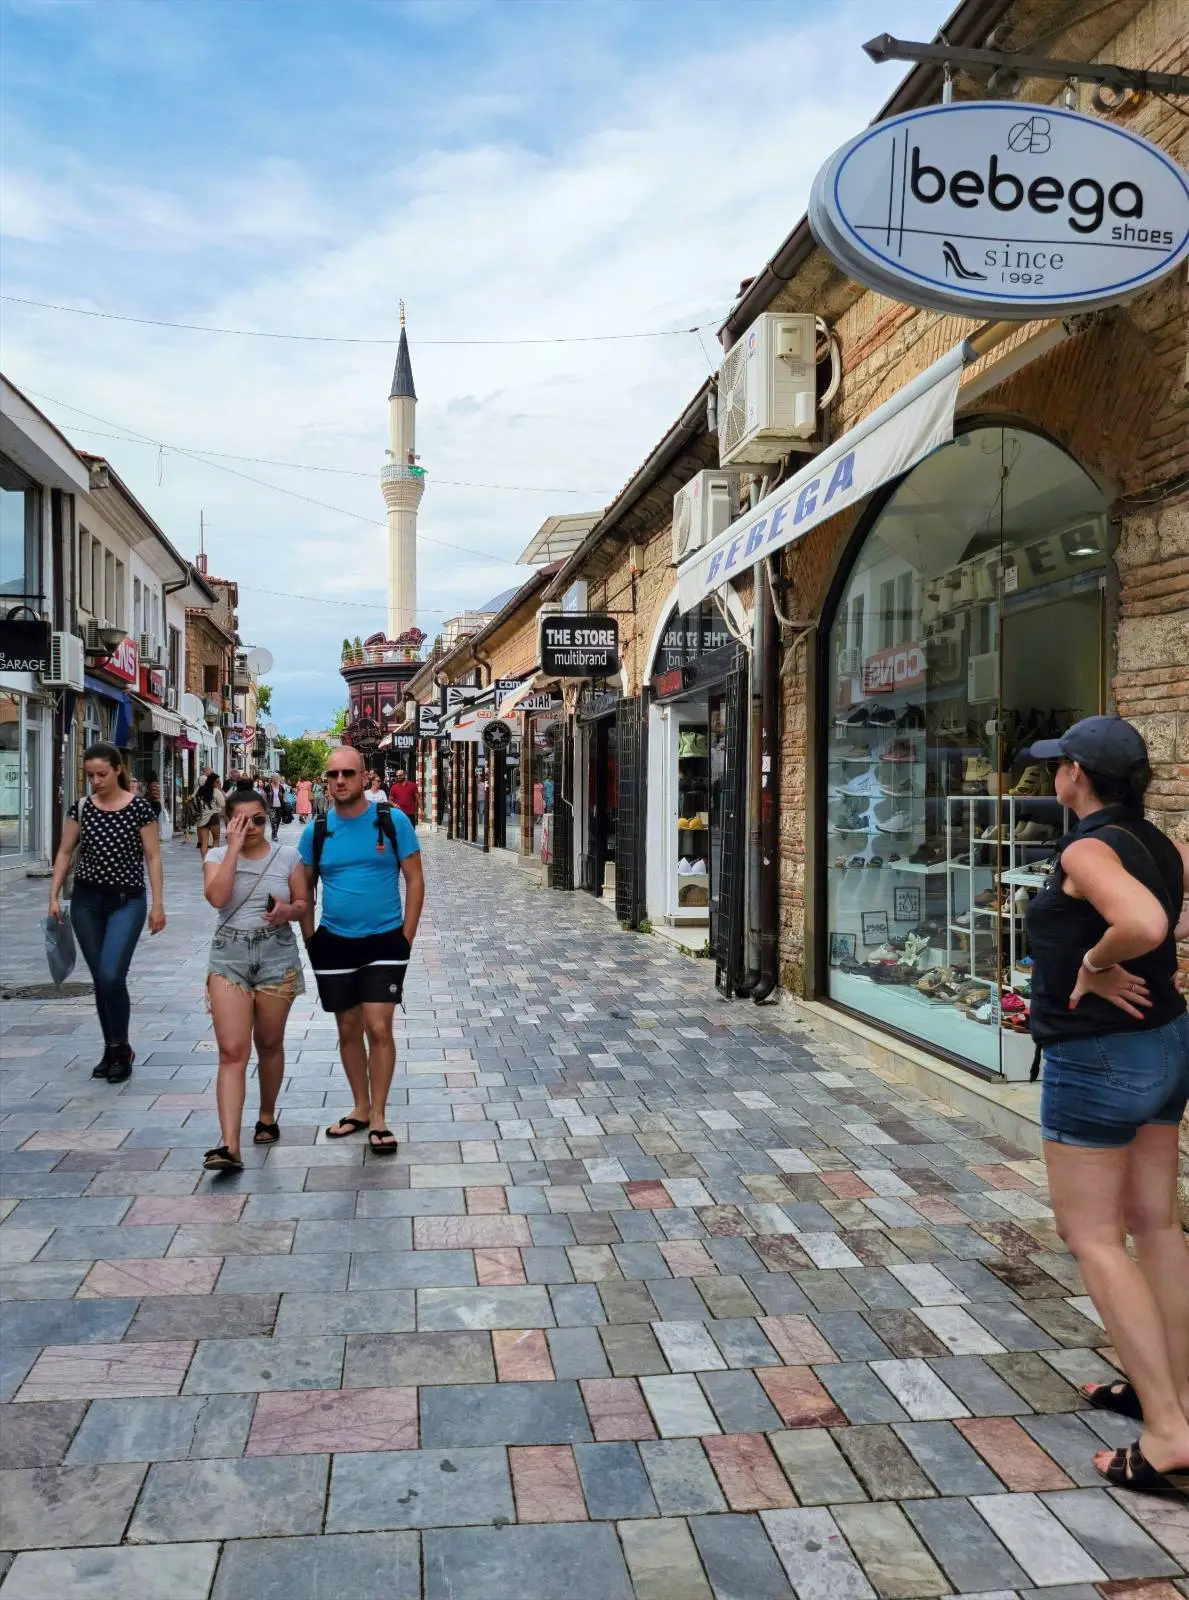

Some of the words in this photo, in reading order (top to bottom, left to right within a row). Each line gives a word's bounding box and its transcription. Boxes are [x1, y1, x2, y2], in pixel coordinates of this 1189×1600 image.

[910, 145, 1145, 234] bebega
[1111, 224, 1173, 245] shoes
[984, 243, 1064, 270] since
[1001, 272, 1045, 285] 1992
[705, 450, 856, 585] BEBEGA
[545, 629, 571, 645] THE
[574, 629, 614, 646] STORE
[0, 659, 47, 671] GARAGE
[109, 641, 135, 676] ONS
[554, 650, 606, 666] multibrand
[394, 735, 414, 746] ICON
